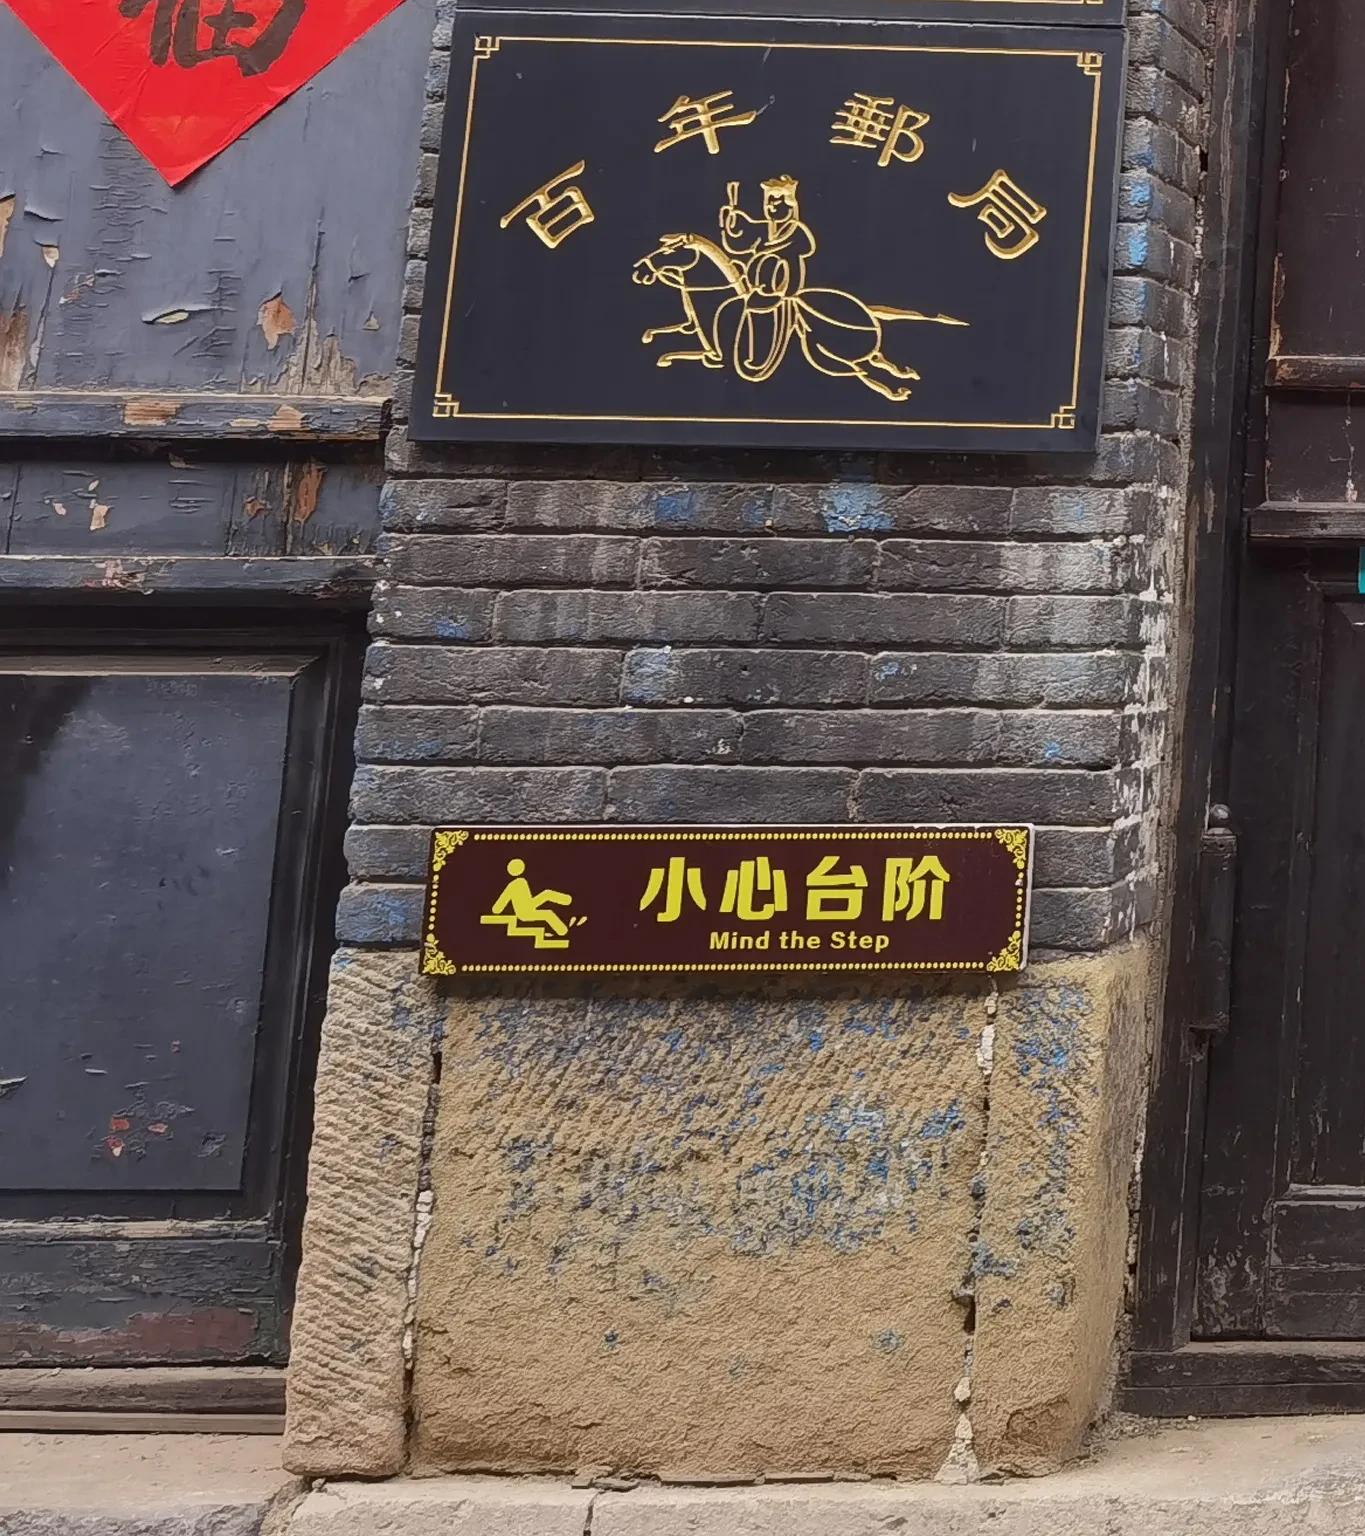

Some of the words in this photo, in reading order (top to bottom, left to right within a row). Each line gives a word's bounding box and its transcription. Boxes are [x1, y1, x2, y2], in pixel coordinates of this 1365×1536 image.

[639, 855, 950, 922] 小心台阶
[709, 931, 770, 951] Mind
[780, 931, 819, 951] the
[831, 931, 890, 955] Step
